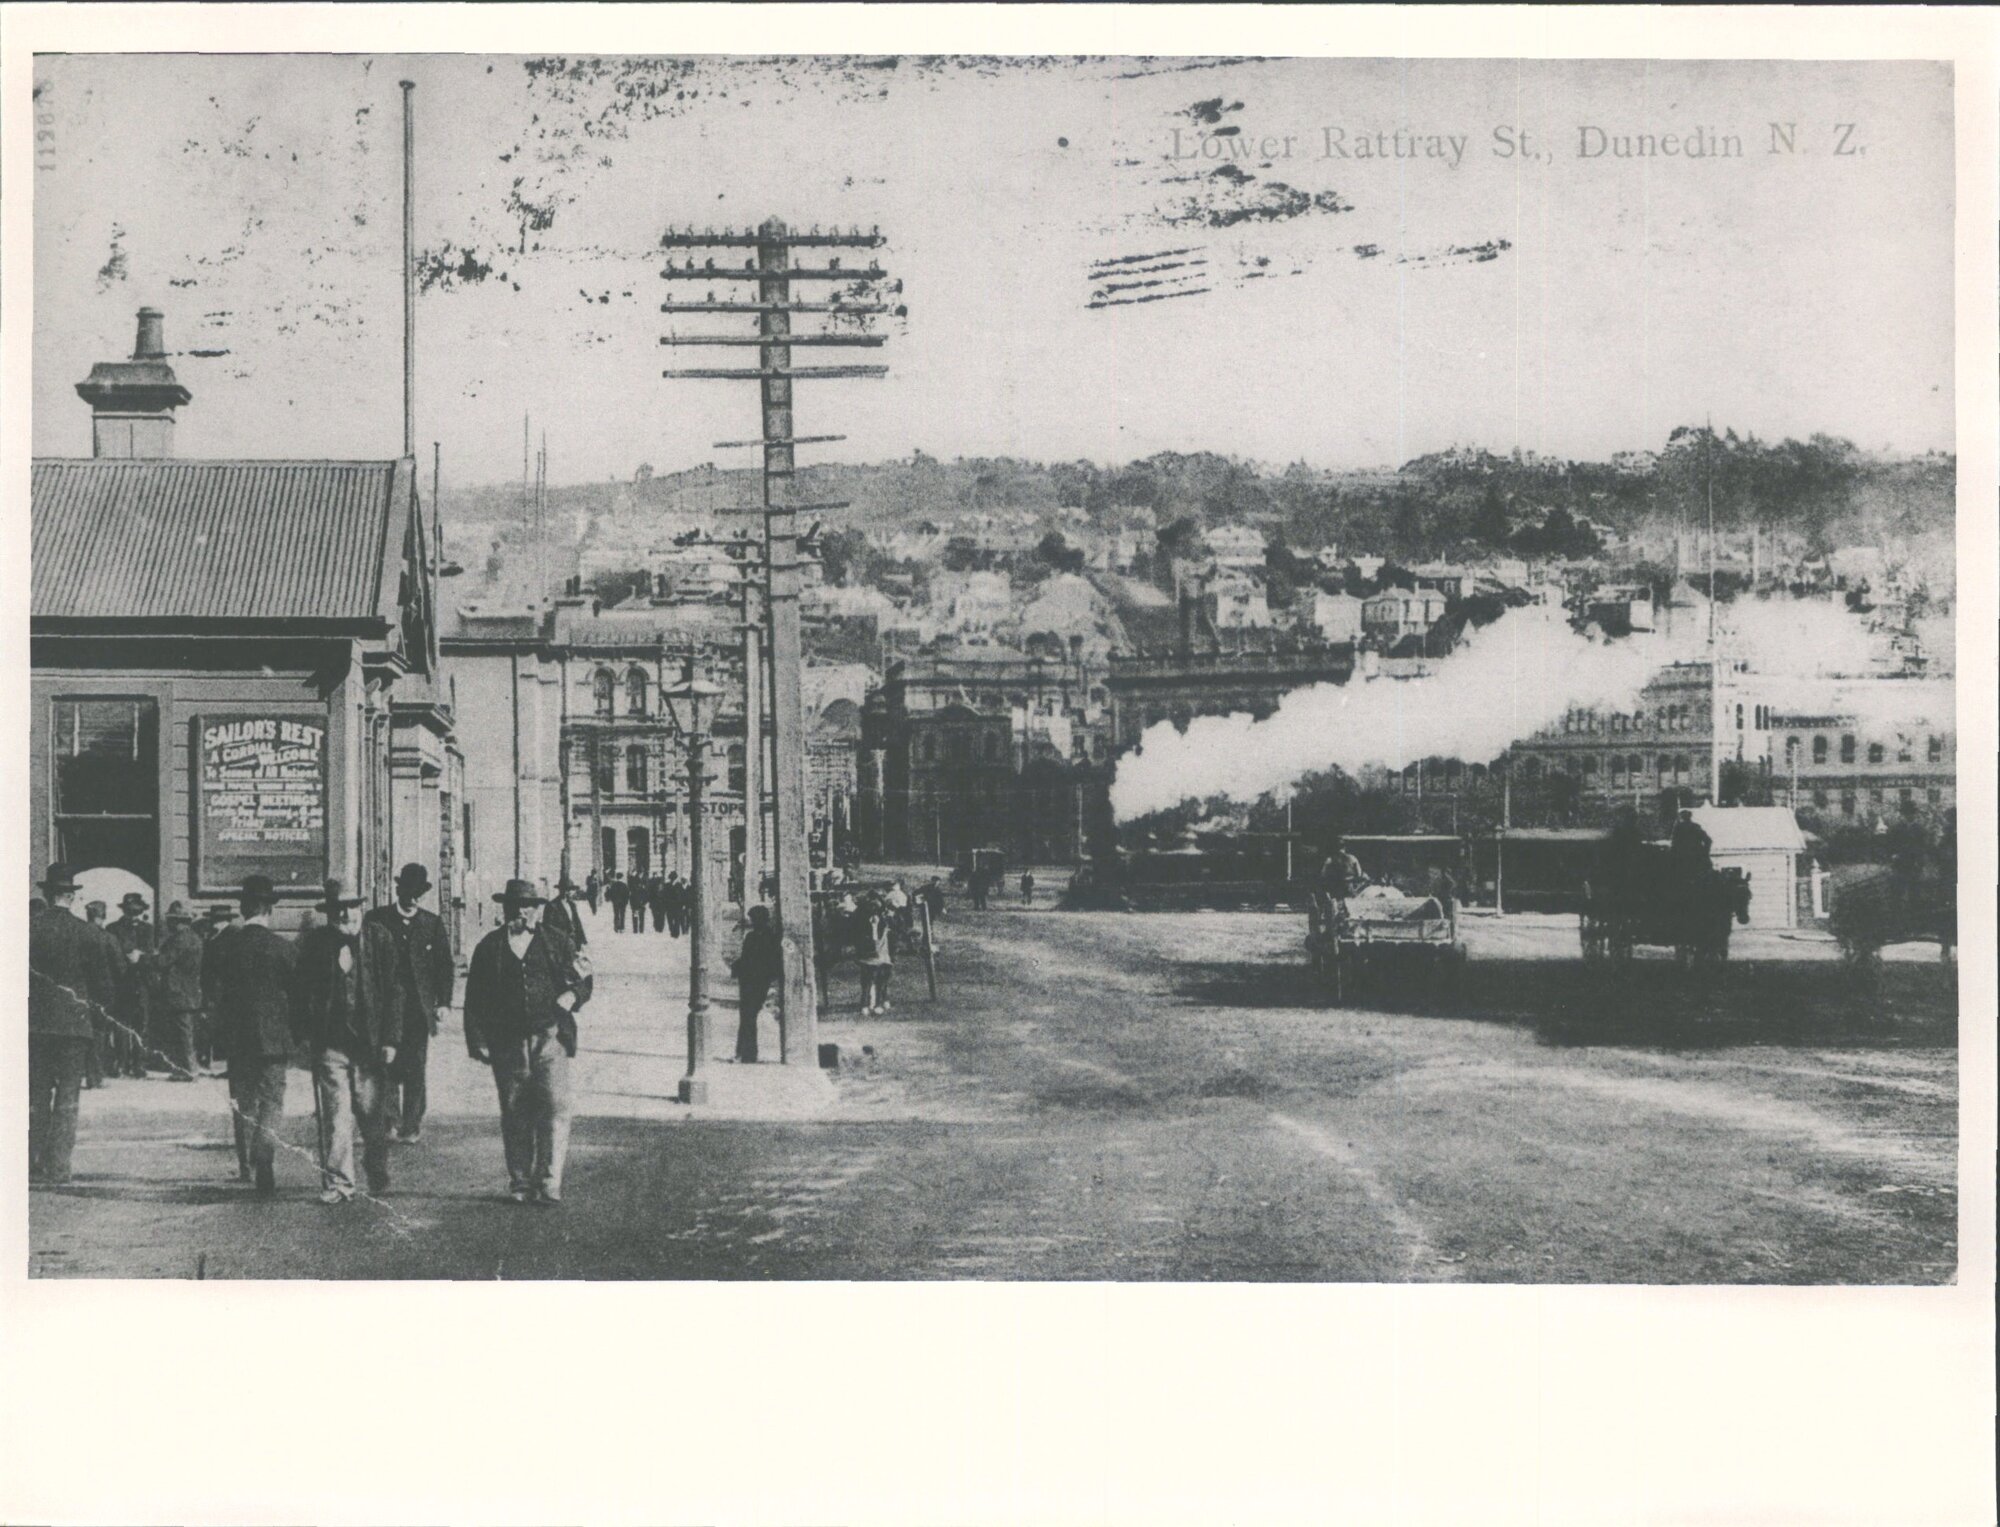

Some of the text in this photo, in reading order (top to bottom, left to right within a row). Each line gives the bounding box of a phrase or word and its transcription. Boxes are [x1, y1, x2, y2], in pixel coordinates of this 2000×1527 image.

[204, 719, 324, 750] SAILOR'S REST
[209, 750, 220, 764] A
[222, 742, 275, 762] CORDIAL
